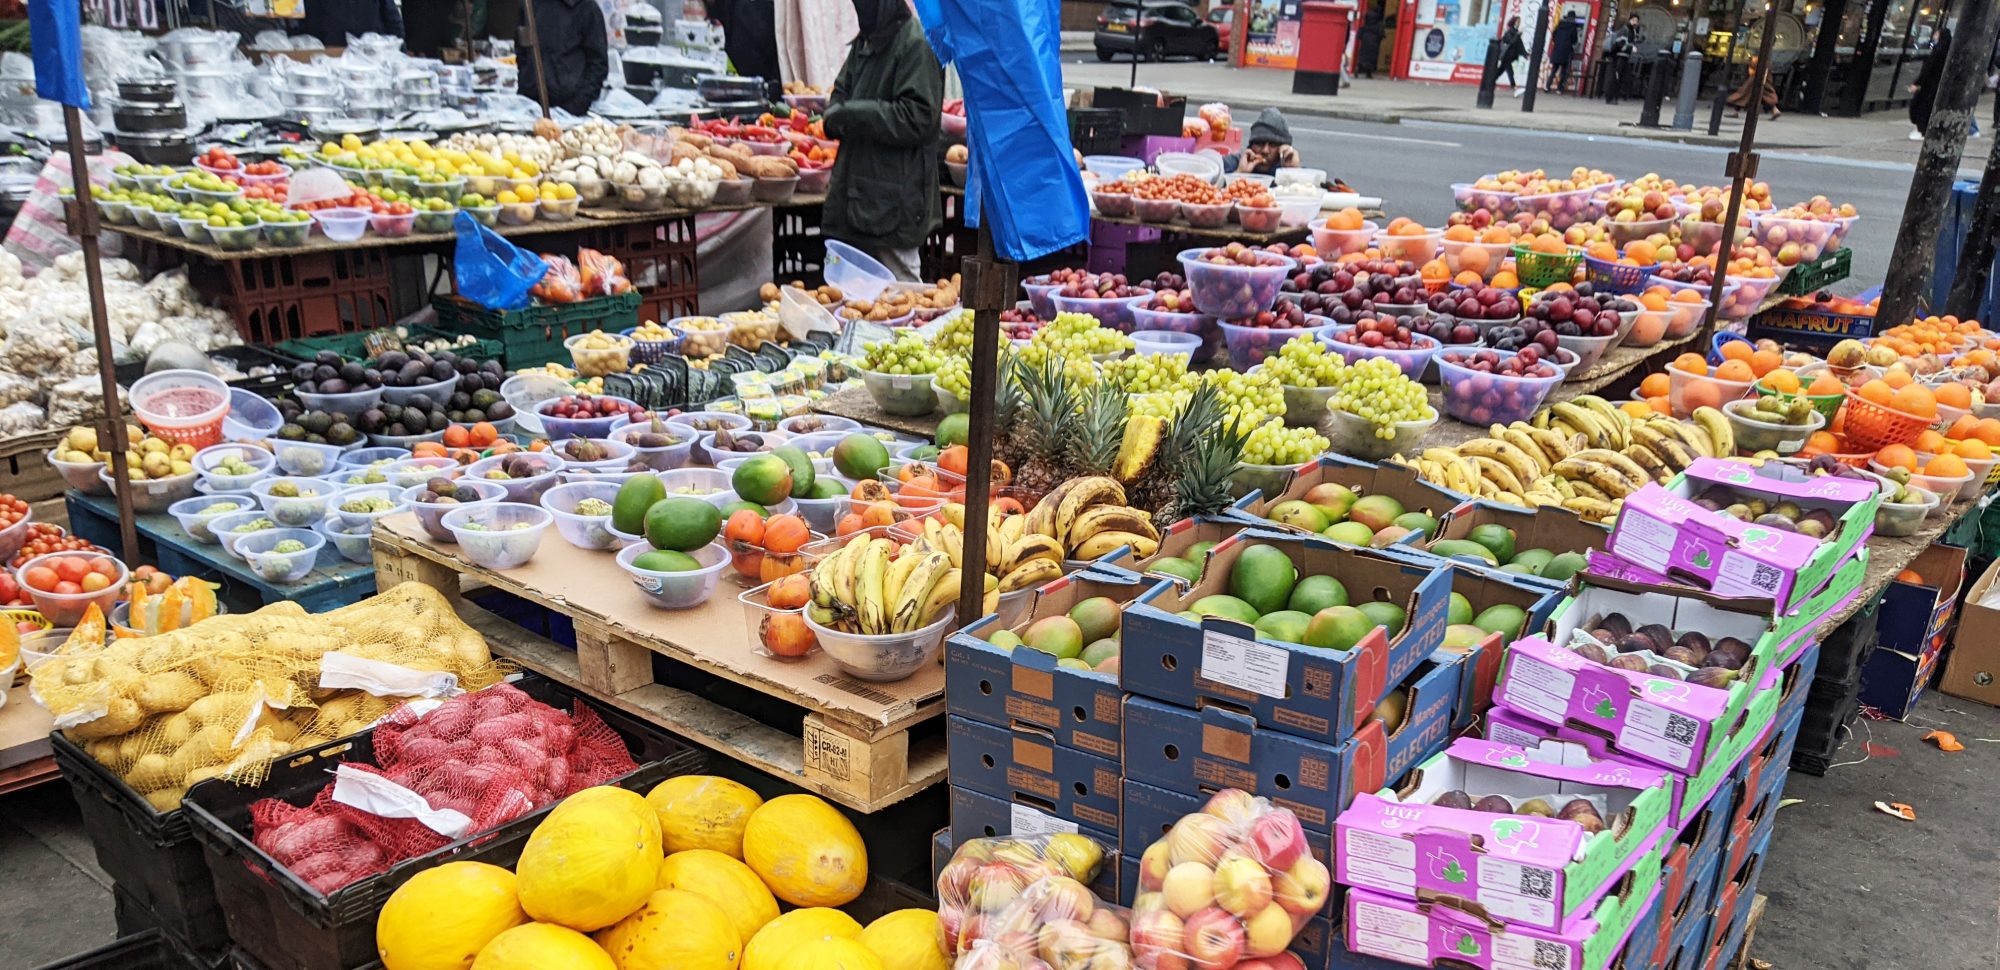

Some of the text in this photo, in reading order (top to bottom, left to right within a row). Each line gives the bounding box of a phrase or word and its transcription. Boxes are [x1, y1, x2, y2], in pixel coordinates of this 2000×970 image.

[1761, 312, 1853, 334] MAFRUT
[1415, 594, 1449, 631] Mangoes
[1388, 617, 1446, 686] SELECTED
[1414, 693, 1449, 728] Mangoes
[1387, 714, 1448, 780] SELECTED
